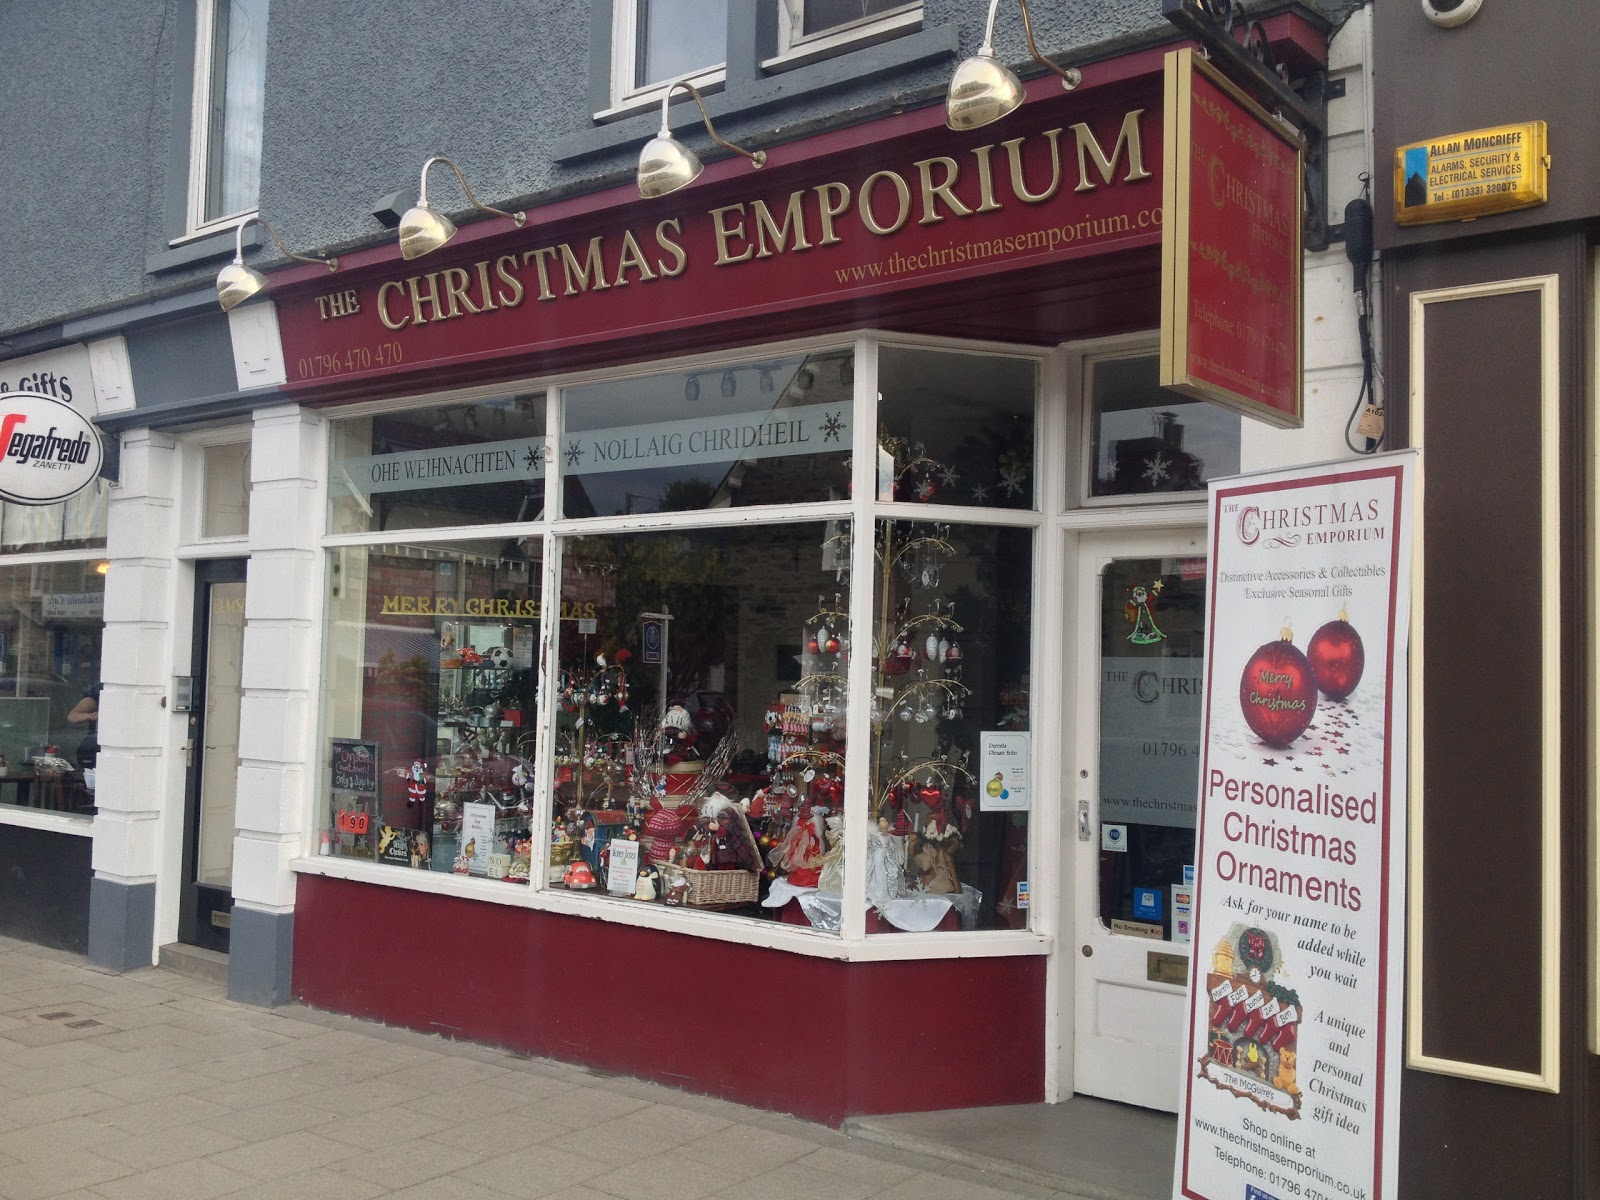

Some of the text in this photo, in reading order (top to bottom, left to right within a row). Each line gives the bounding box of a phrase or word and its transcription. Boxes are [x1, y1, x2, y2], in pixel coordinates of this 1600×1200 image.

[1430, 132, 1522, 157] ALLAN MONCRIEFF
[1469, 152, 1511, 169] SECURITY
[1513, 151, 1520, 162] &
[1430, 164, 1522, 187] ELECTRICAL SERVICES
[1452, 187, 1483, 199] (01333)
[1486, 181, 1517, 194] 320075
[1208, 155, 1289, 237] CHRISTMAS
[315, 109, 1153, 330] THE CHRISTMAS EMPORIUM
[835, 207, 1163, 284] www.thechristmasemporium.co
[299, 341, 402, 378] 01796 470 470
[593, 420, 811, 462] NOLLAIG CHRIDHEIL
[33, 460, 71, 471] ZANETTI
[372, 449, 516, 483] OHE WEIHNACHTEN
[1224, 499, 1385, 547] THE CHRISTMAS EMPORIUM
[1220, 564, 1385, 583] Distinctive Accessories & Collectables
[1245, 585, 1353, 599] Exclusive Seasonal Gifts
[383, 596, 597, 619] MERRY CHRISMAS
[1105, 671, 1128, 682] THE
[1260, 670, 1293, 690] Merry
[1250, 692, 1306, 711] Christmas
[1142, 741, 1187, 758] 01796
[1210, 769, 1377, 825] Personalised
[1223, 811, 1357, 866] Christmas
[1216, 851, 1362, 912] Ornaments
[1123, 925, 1149, 935] Smoking
[1222, 895, 1357, 940] Ask for your name to be
[1297, 938, 1367, 968] added while
[1308, 964, 1358, 989] you wait
[1212, 983, 1230, 1000] Martin
[1280, 1009, 1292, 1024] Ben
[1314, 1010, 1366, 1039] A unique
[1328, 1039, 1351, 1058] and
[1224, 1073, 1275, 1100] The McGuire's
[1312, 1058, 1363, 1087] personal
[1309, 1077, 1368, 1114] Christmas
[1312, 1106, 1360, 1135] gift idea
[1242, 1117, 1316, 1159] Shop online at
[1195, 1117, 1367, 1200] www.thechristmasemporium.co.uk
[1215, 1145, 1267, 1180] Telephone:
[1269, 1171, 1301, 1195] 01796
